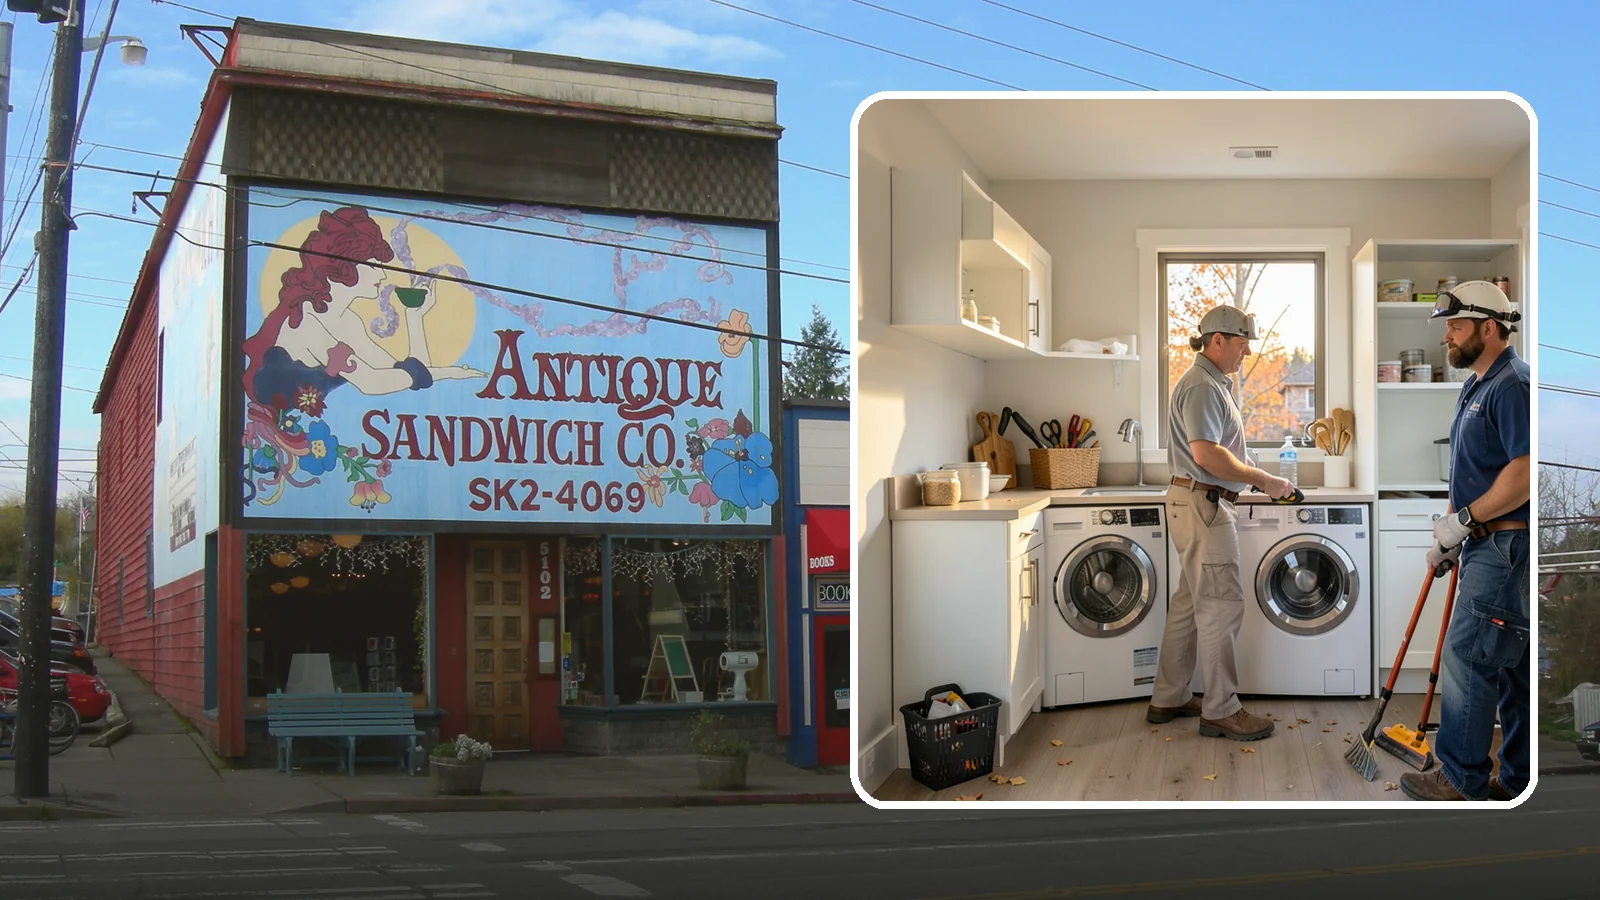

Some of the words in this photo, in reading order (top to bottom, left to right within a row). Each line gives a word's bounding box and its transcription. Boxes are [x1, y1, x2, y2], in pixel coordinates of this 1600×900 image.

[476, 329, 723, 420] ANTIQUE
[361, 409, 604, 466] SANDWICH
[617, 422, 685, 468] CO.
[468, 477, 645, 512] SK2-4069
[539, 541, 551, 599] 5102
[809, 555, 835, 569] BOOKS
